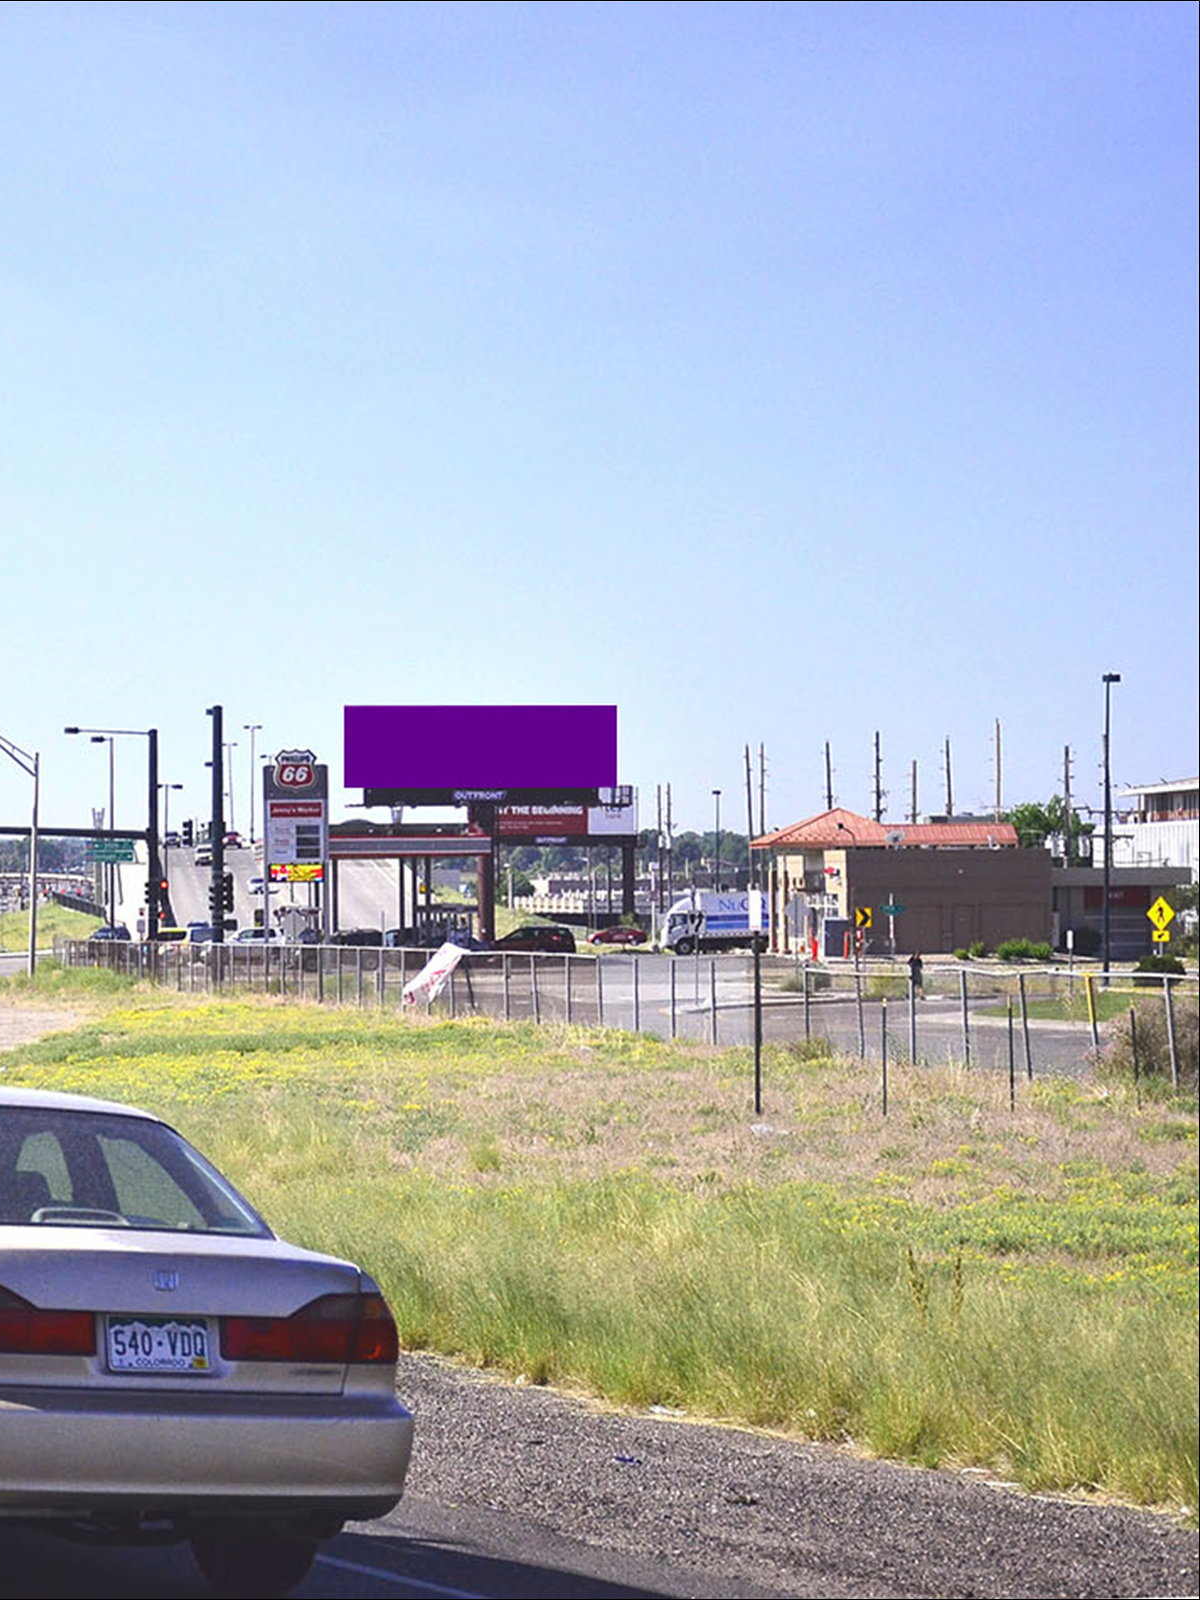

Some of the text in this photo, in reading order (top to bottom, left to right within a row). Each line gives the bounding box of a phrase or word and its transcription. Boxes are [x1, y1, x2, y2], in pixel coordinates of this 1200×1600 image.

[282, 766, 308, 782] 66
[454, 790, 504, 800] OUTFRONT
[511, 806, 530, 815] THE
[531, 805, 583, 815] BEGINNING
[136, 1358, 186, 1367] COLORADO
